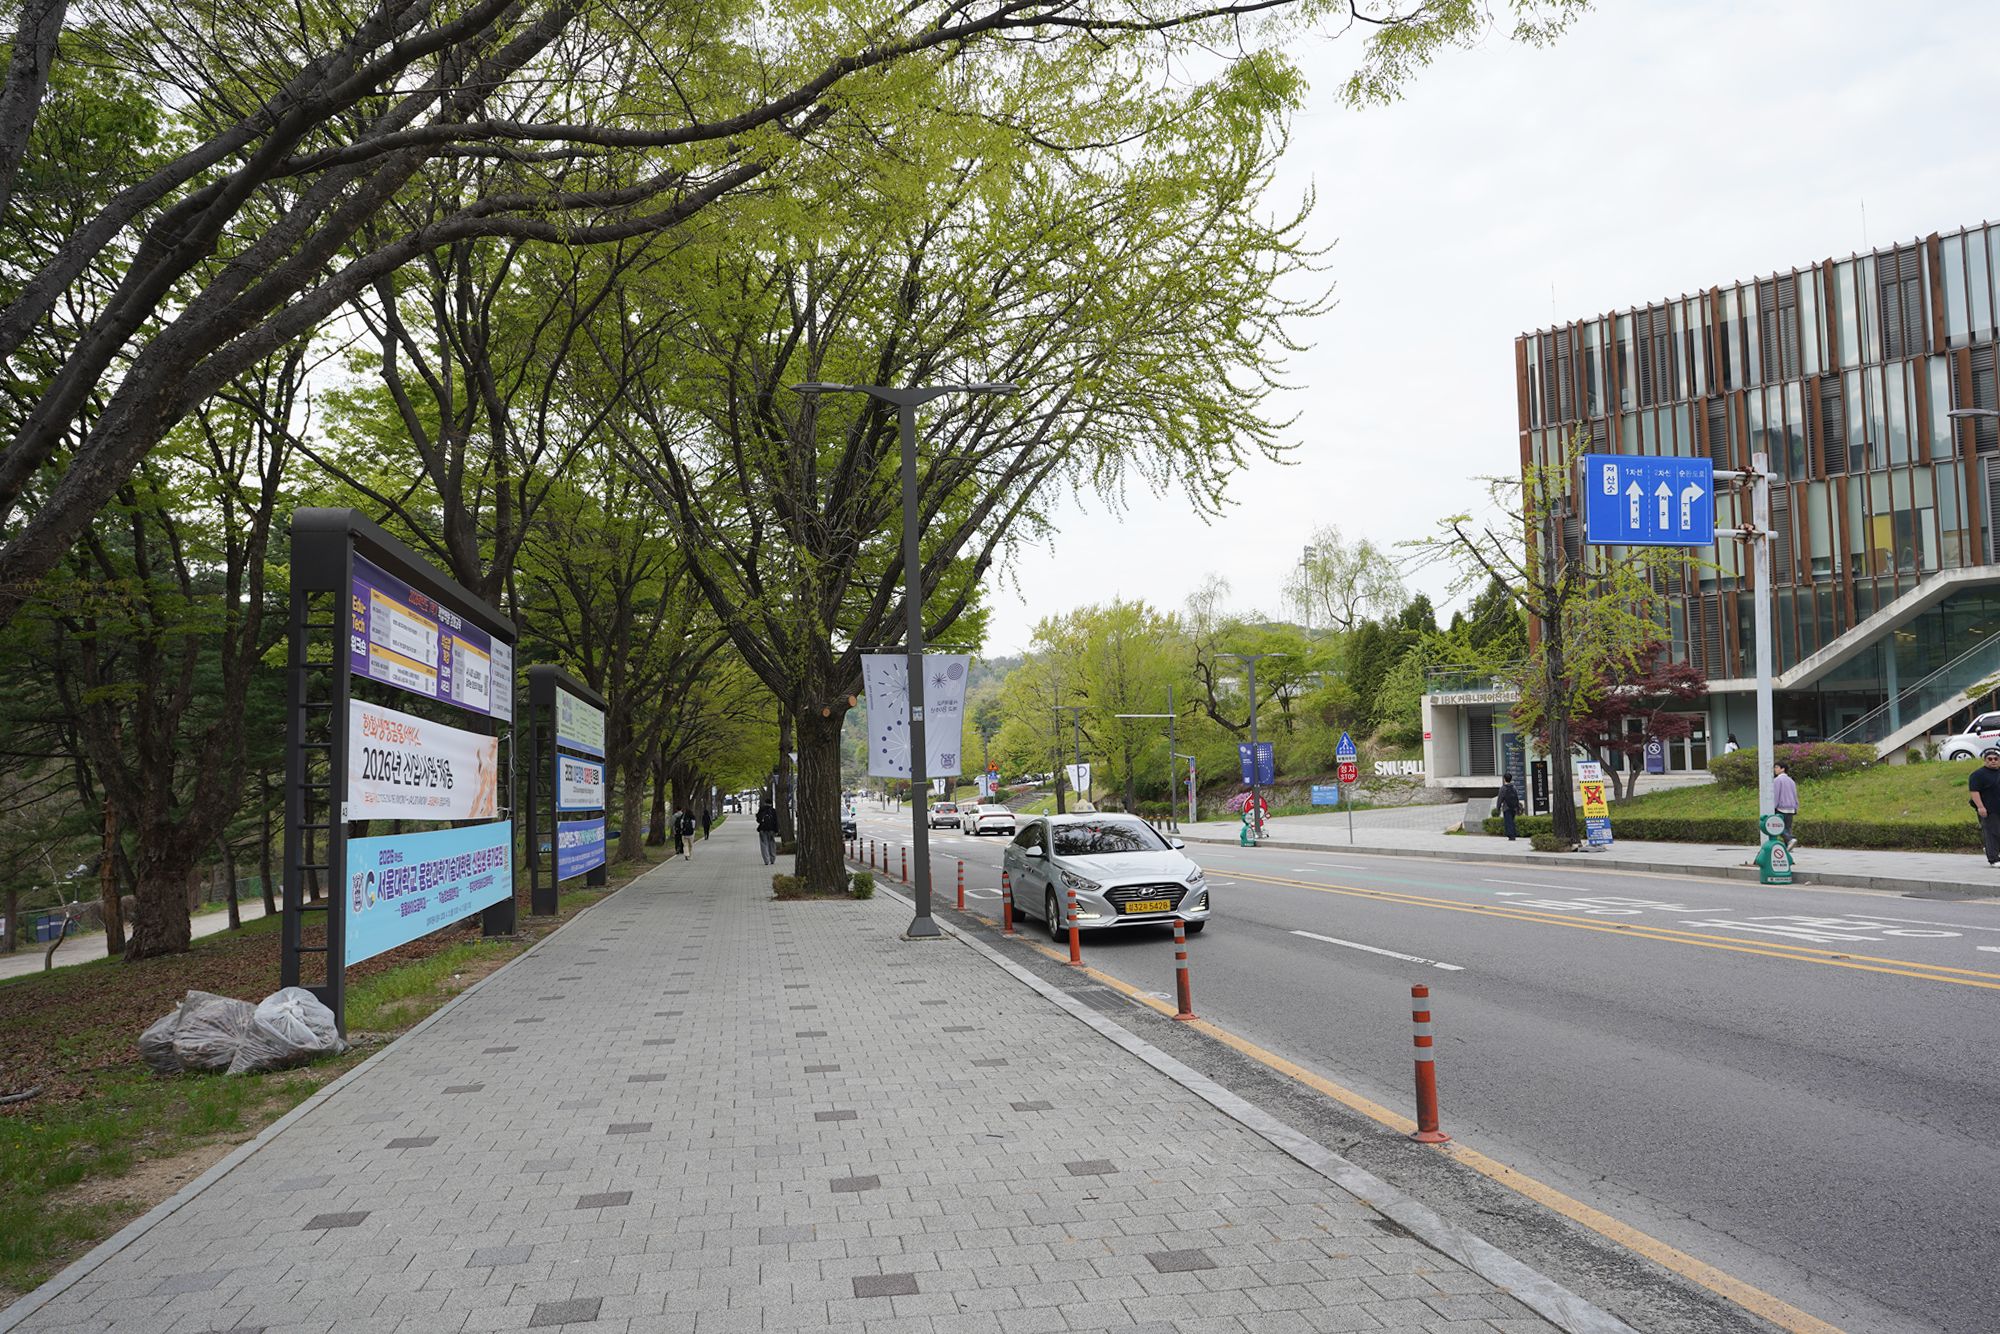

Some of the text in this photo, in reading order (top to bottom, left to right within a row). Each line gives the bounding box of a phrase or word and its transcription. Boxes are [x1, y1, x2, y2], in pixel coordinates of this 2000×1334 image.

[352, 614, 366, 634] Tech
[362, 747, 454, 790] 2026년 신입사원 채용
[377, 865, 418, 900] 서울대학교
[419, 853, 472, 891] 융합과학기술대학원
[1149, 901, 1168, 910] 5428
